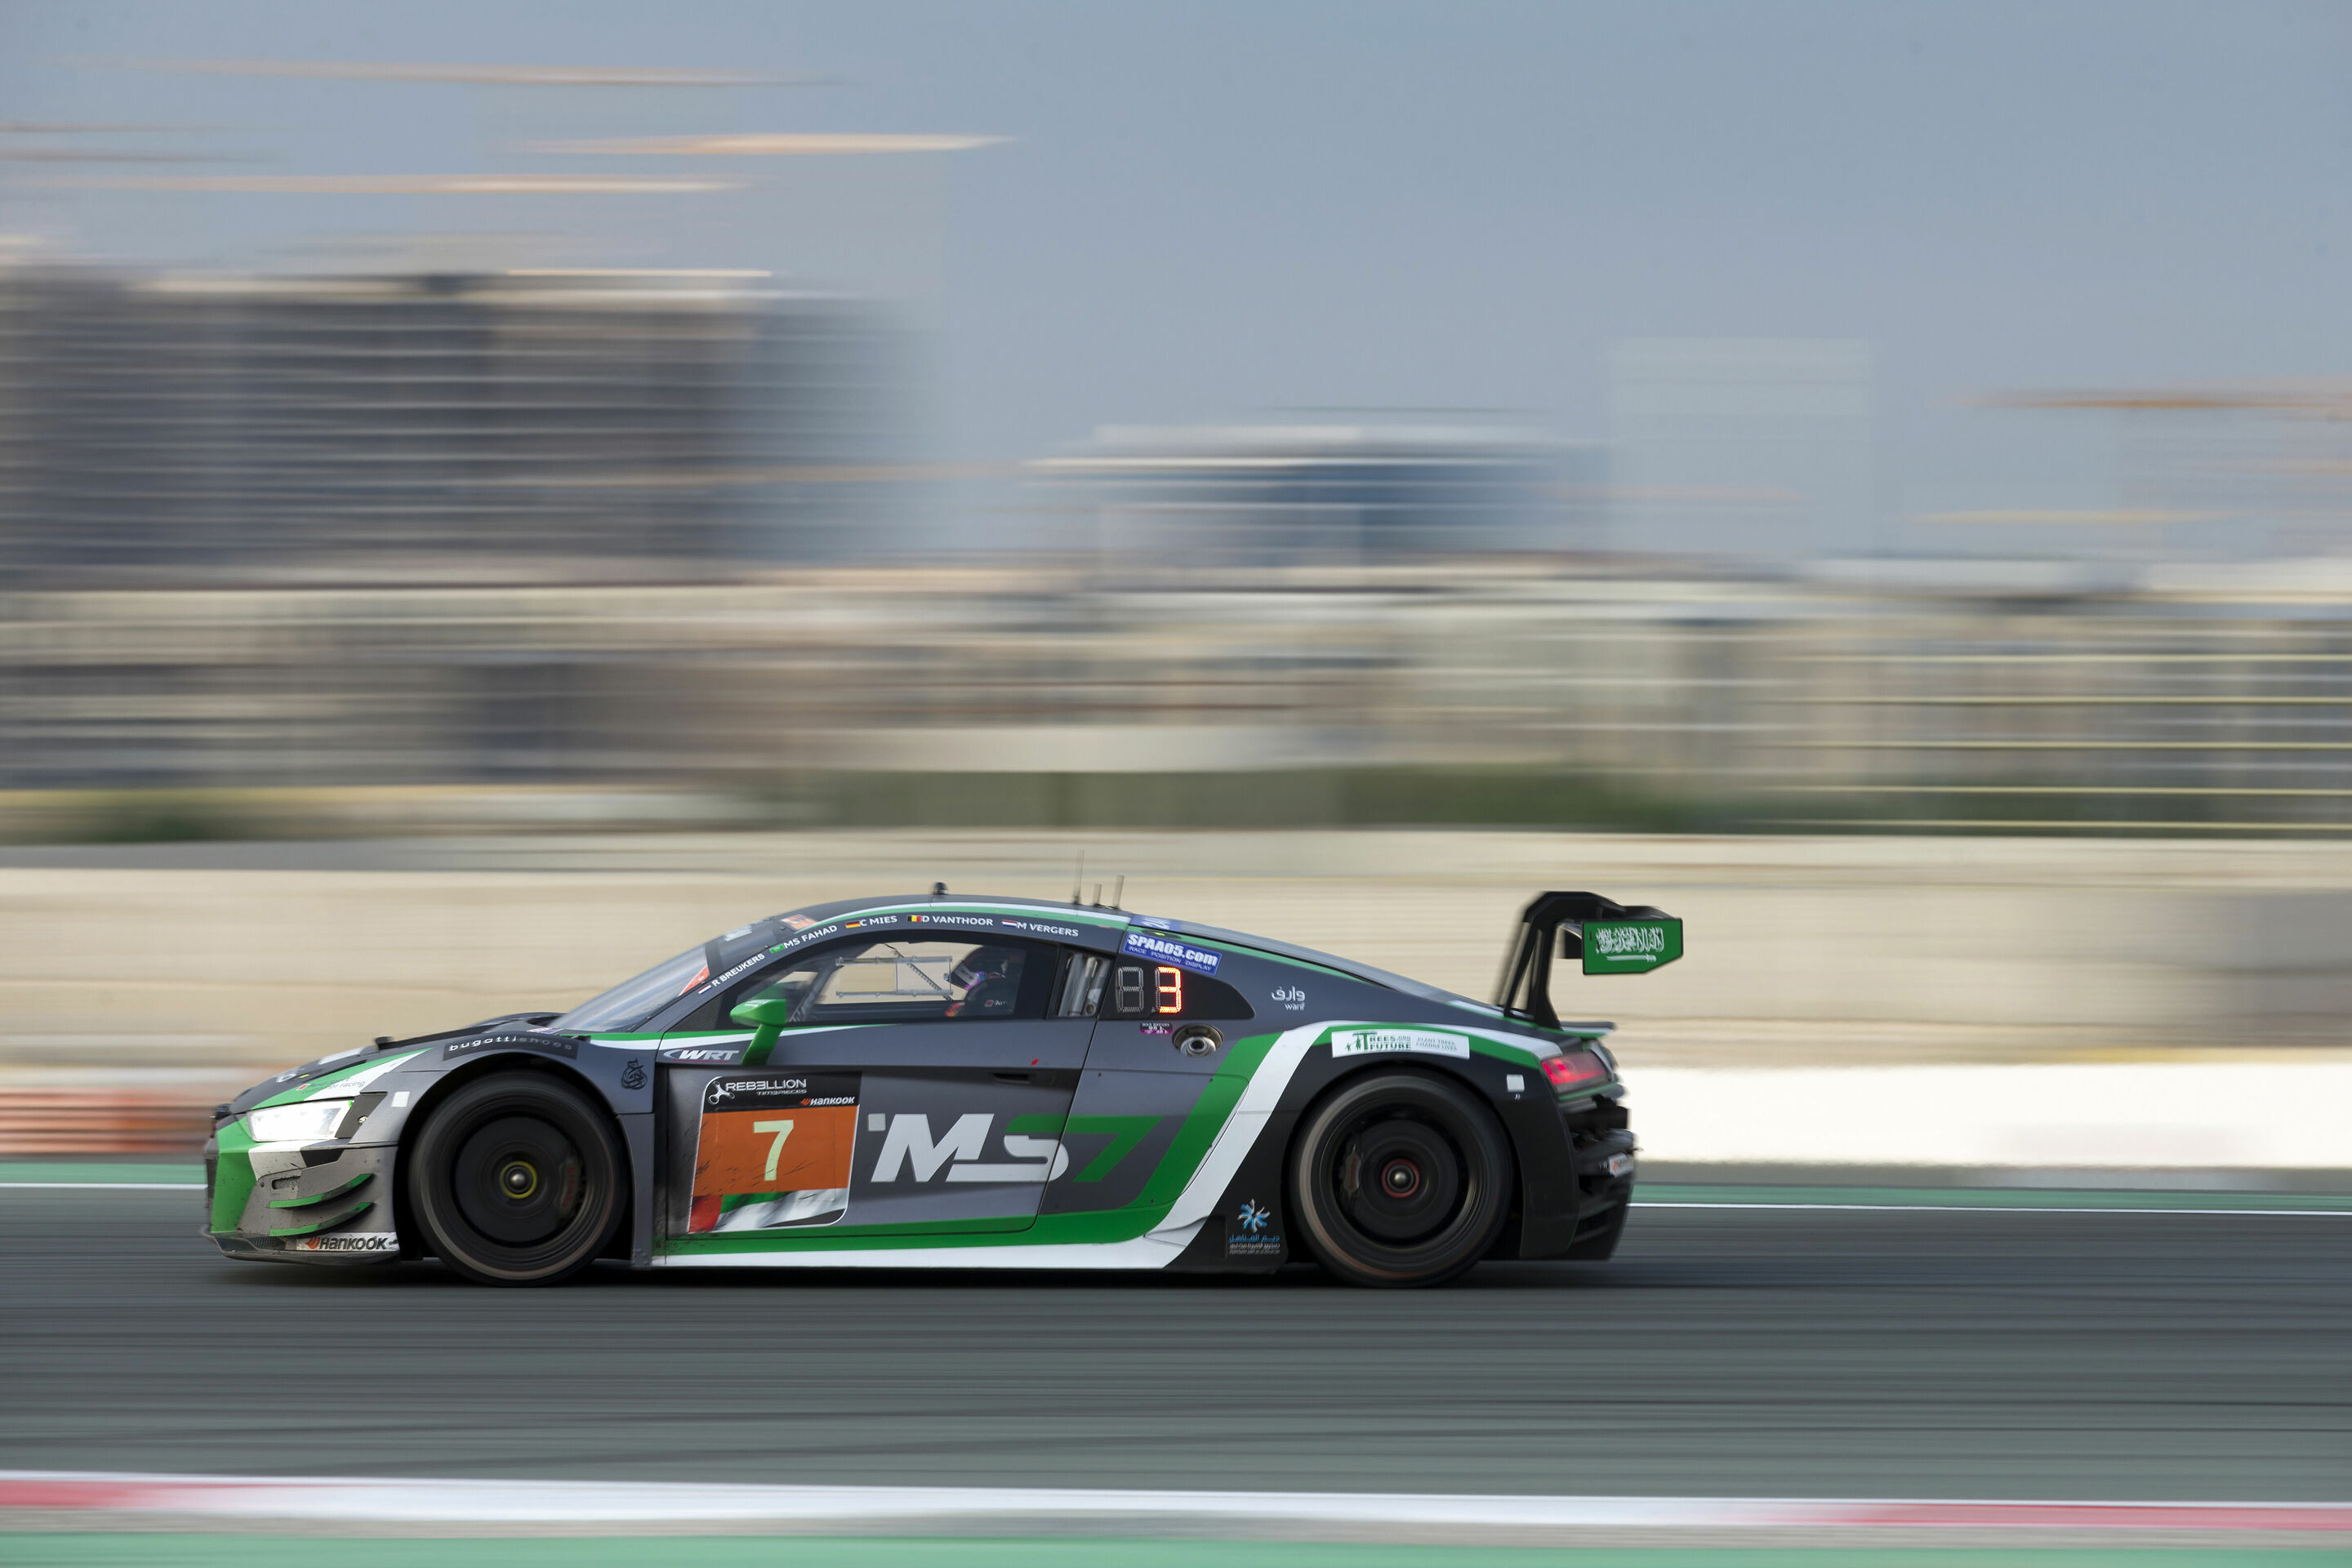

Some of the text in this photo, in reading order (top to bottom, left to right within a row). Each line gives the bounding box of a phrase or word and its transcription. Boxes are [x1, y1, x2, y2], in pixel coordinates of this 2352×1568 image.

[870, 915, 898, 925] MIES
[932, 915, 993, 926] VANTHOOR
[783, 924, 838, 949] MS FAHAD
[1029, 924, 1079, 937] VERGERS
[1128, 933, 1218, 967] SPAA05.com
[1129, 947, 1212, 972] RACE POSITION DISPLAY
[711, 953, 765, 987] R BREUKERS
[679, 1049, 739, 1060] WRT
[340, 1080, 366, 1089] racing
[753, 1119, 795, 1182] 7
